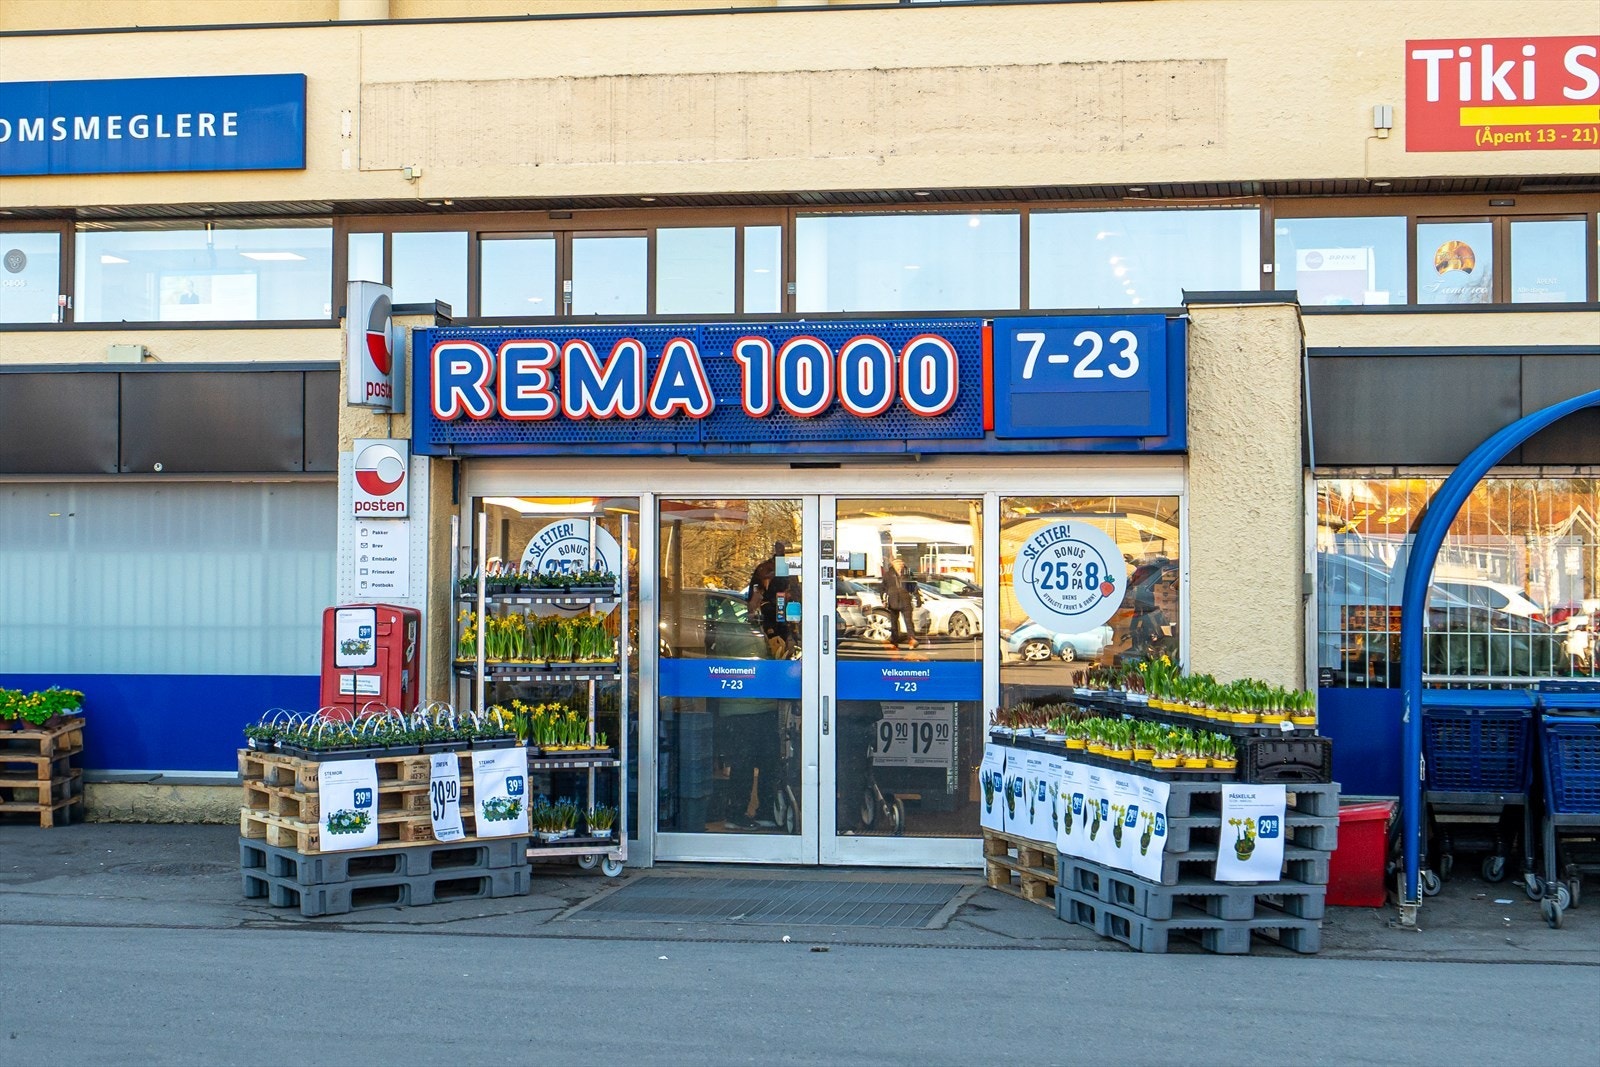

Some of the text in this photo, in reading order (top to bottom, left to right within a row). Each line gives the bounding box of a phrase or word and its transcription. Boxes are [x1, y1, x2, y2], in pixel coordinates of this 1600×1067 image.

[1412, 44, 1600, 102] Tiki S
[1475, 126, 1531, 146] (Åpent
[1537, 128, 1556, 142] 13
[1572, 127, 1598, 145] 21)
[1016, 330, 1139, 379] 7-23
[431, 334, 959, 420] REMA 1000
[354, 499, 405, 514] posten
[529, 523, 574, 558] SE ETTER!
[1023, 525, 1071, 560] SE ETTER!
[558, 543, 588, 557] BONUS
[1054, 545, 1086, 559] BONUS
[1085, 562, 1099, 590] 8
[708, 666, 756, 675] Velkommen!
[881, 668, 930, 677] Velkommen!
[721, 679, 743, 690] 7-23
[894, 682, 917, 692] 7-23
[911, 721, 933, 754] 19
[508, 779, 518, 792] 39
[355, 791, 366, 805] 39
[431, 780, 445, 822] 39
[1260, 819, 1271, 834] 29
